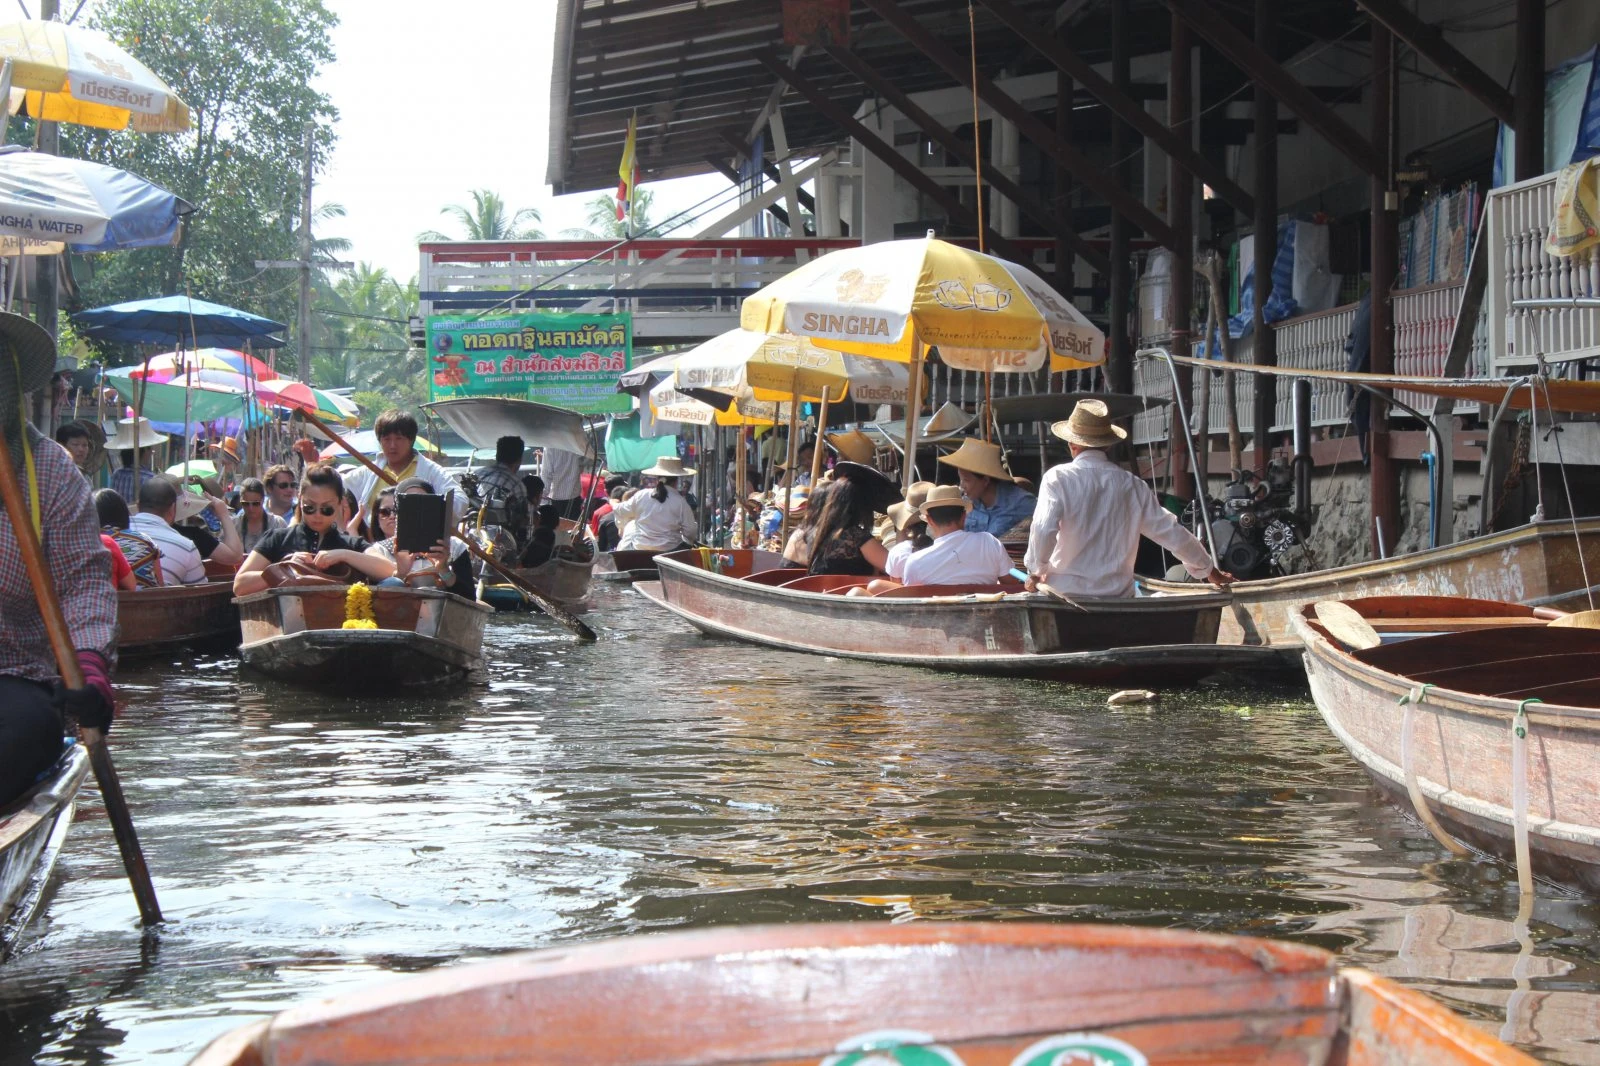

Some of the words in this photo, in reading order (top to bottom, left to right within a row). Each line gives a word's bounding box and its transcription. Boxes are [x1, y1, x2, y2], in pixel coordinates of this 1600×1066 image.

[38, 219, 83, 235] WATER
[802, 312, 890, 337] SINGHA
[462, 325, 625, 351] ทอดกฐินสามัคคี
[1051, 330, 1093, 355] บียร์สิงห์
[474, 360, 496, 374] ณ
[687, 367, 735, 384] SINGHA
